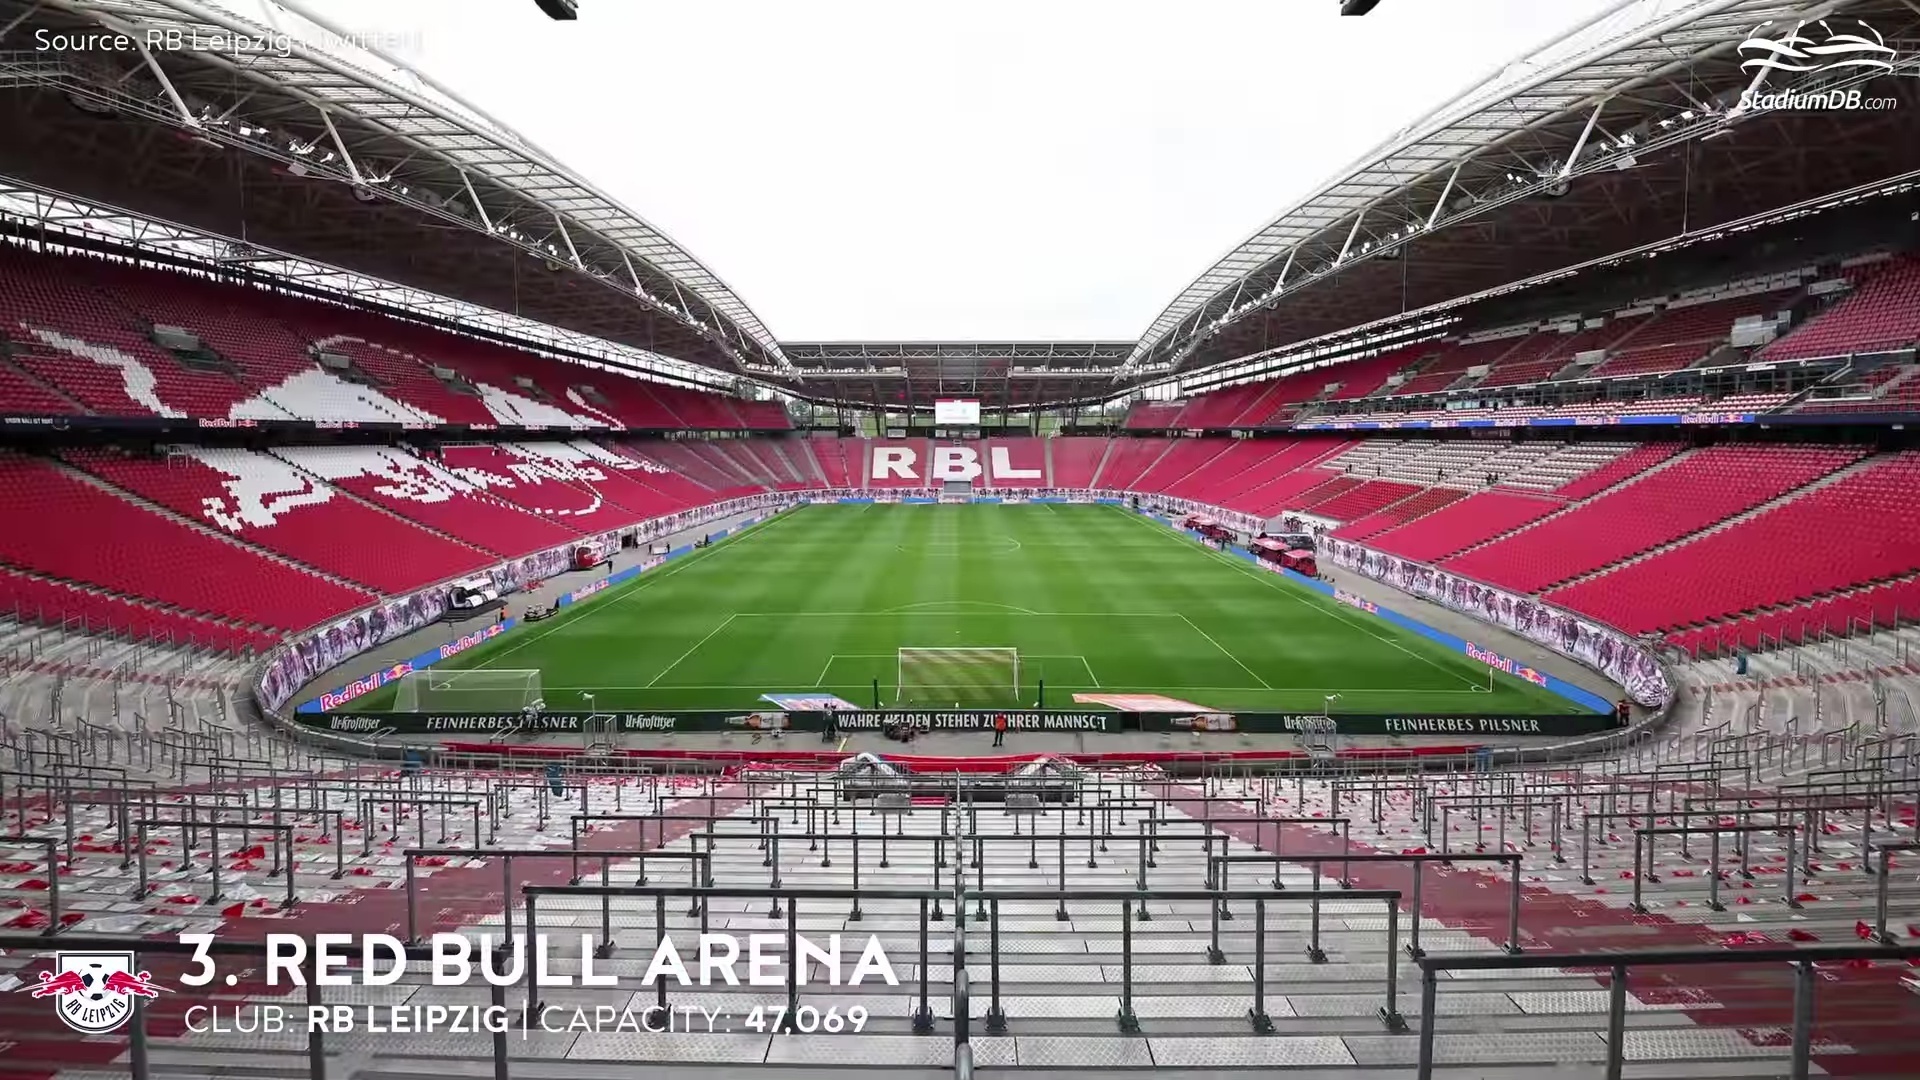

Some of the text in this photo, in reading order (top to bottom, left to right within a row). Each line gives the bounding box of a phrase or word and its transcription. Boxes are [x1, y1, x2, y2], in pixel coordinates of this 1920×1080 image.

[872, 446, 1042, 479] RBL
[440, 630, 482, 659] Red Bull
[1466, 641, 1512, 673] Red Bull
[320, 672, 381, 712] Red Bull
[426, 716, 513, 729] FEINHERBES
[838, 714, 881, 728] WAHRE
[935, 714, 979, 728] STEHEN
[1003, 714, 1040, 728] HRER
[1385, 718, 1474, 731] FEINHERBES
[1479, 719, 1541, 732] PILSNER
